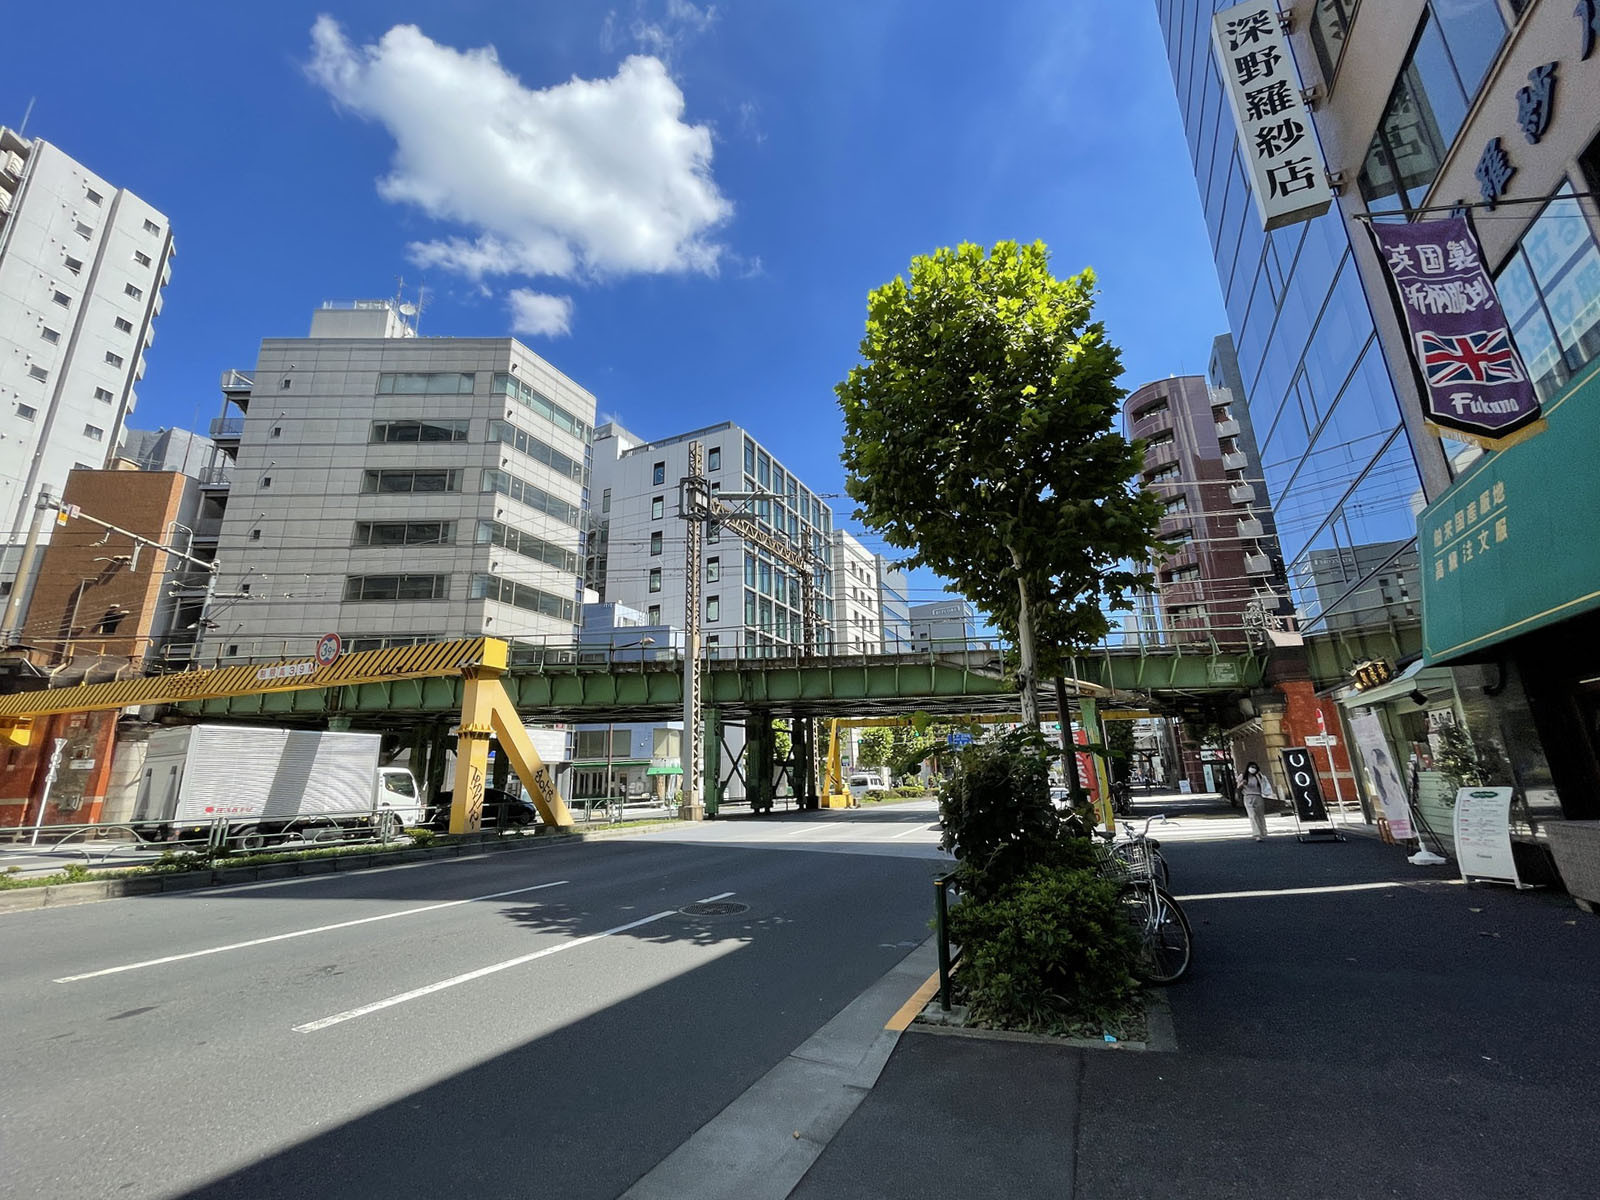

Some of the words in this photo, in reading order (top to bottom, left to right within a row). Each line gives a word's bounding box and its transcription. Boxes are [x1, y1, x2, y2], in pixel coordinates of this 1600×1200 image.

[1225, 9, 1316, 200] 深野羅紗店
[1384, 238, 1480, 274] 英国製
[1449, 391, 1519, 415] Fukano
